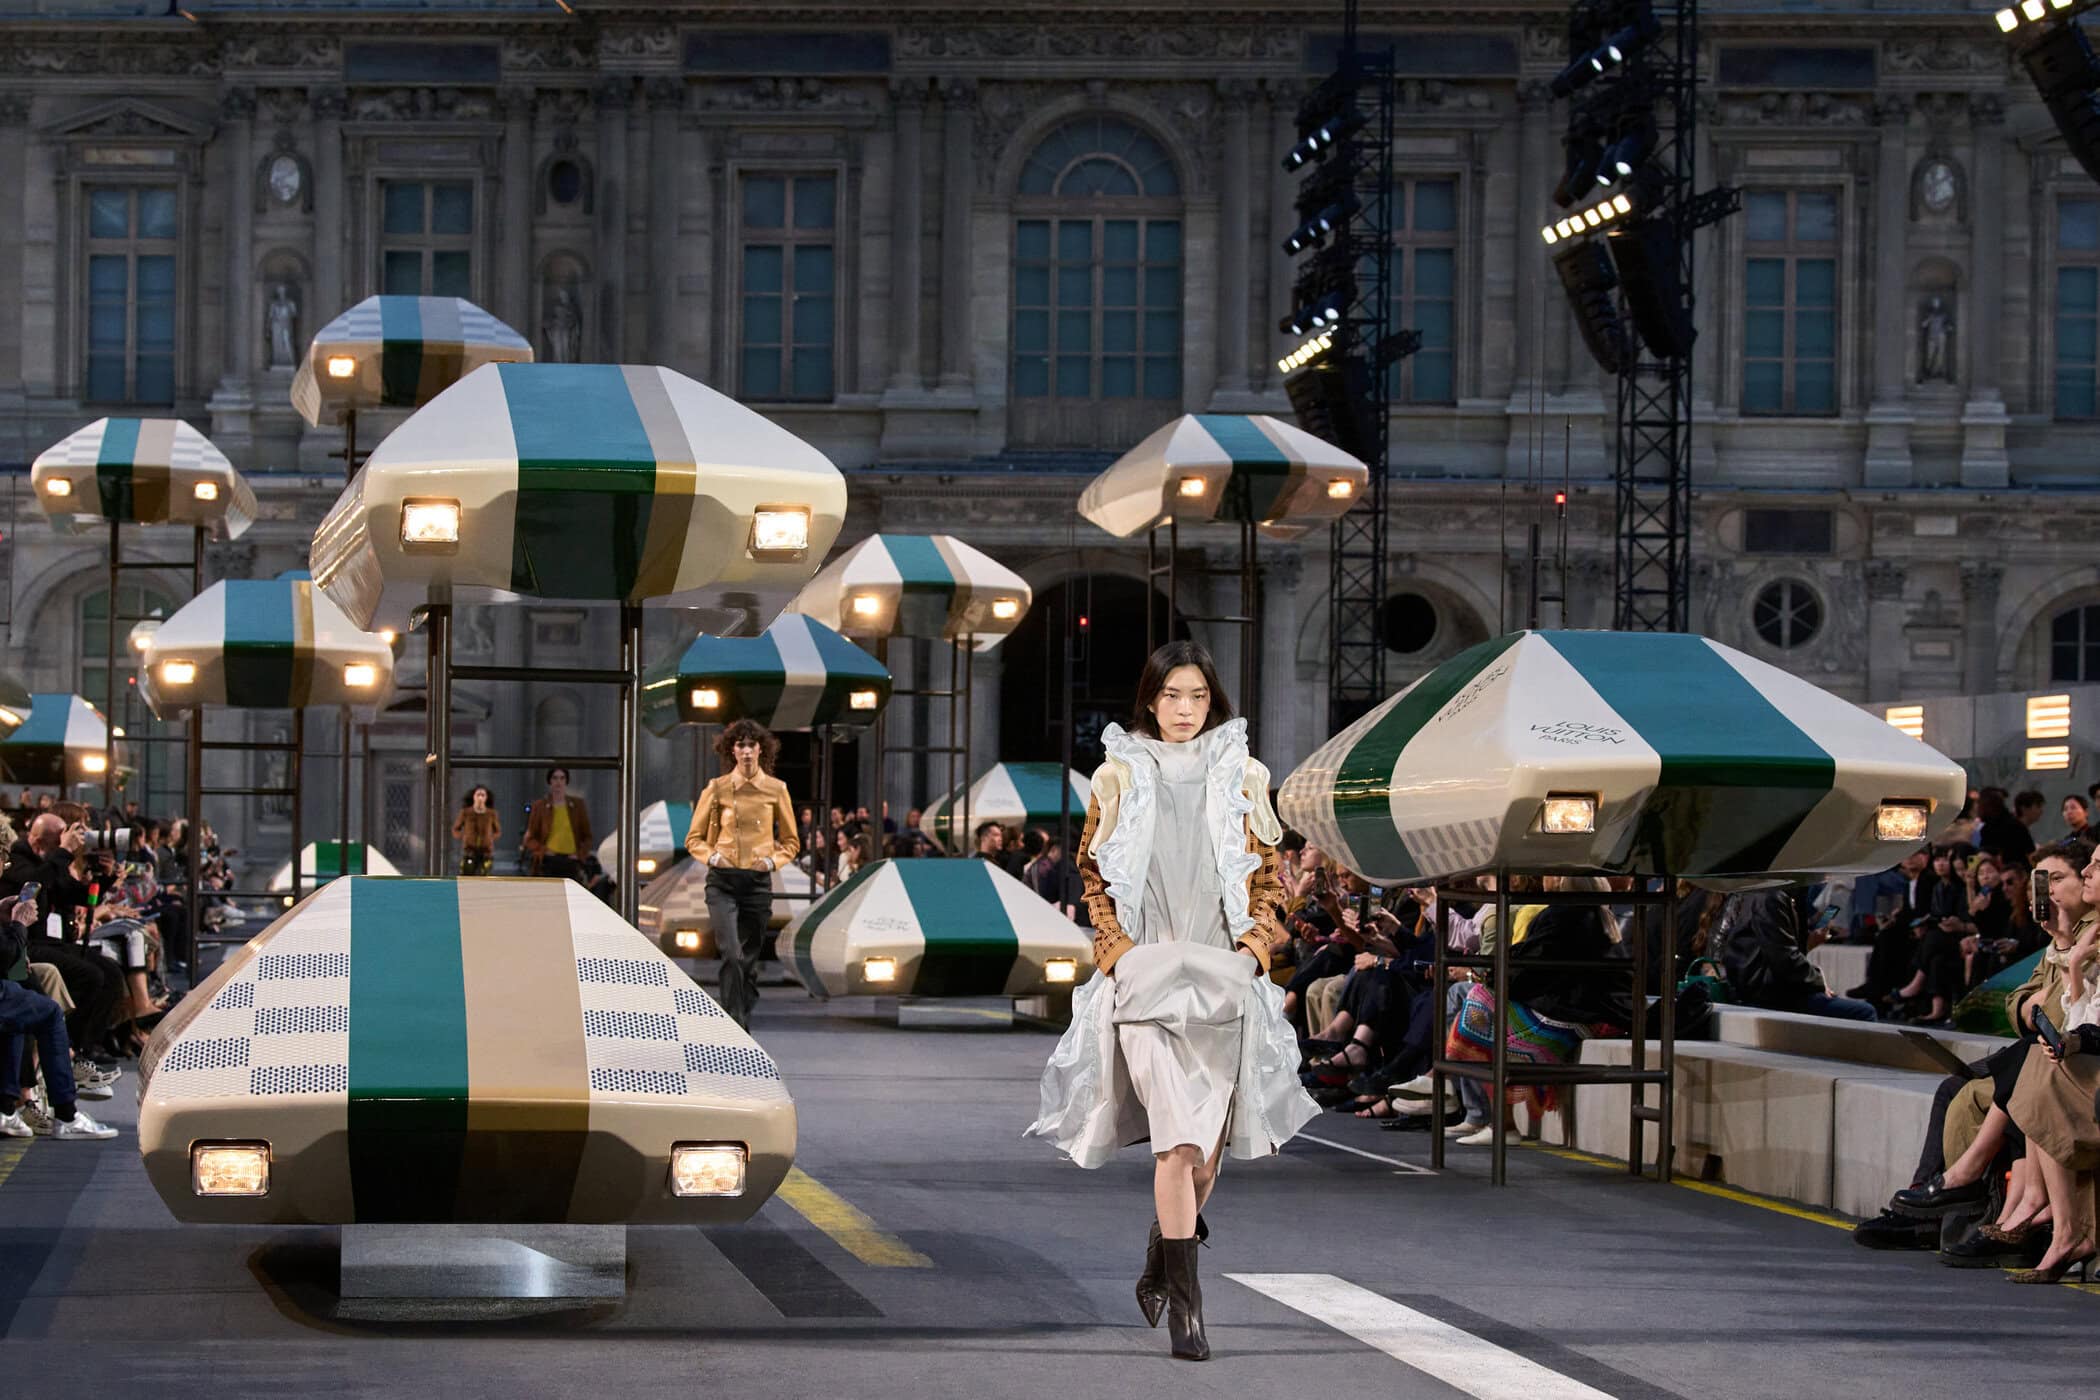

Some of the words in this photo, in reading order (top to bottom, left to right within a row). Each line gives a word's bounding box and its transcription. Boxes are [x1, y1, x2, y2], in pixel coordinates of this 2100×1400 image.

[1531, 724, 1625, 744] VUITTON
[1556, 721, 1622, 736] LOUIS
[1538, 734, 1581, 744] PARIS
